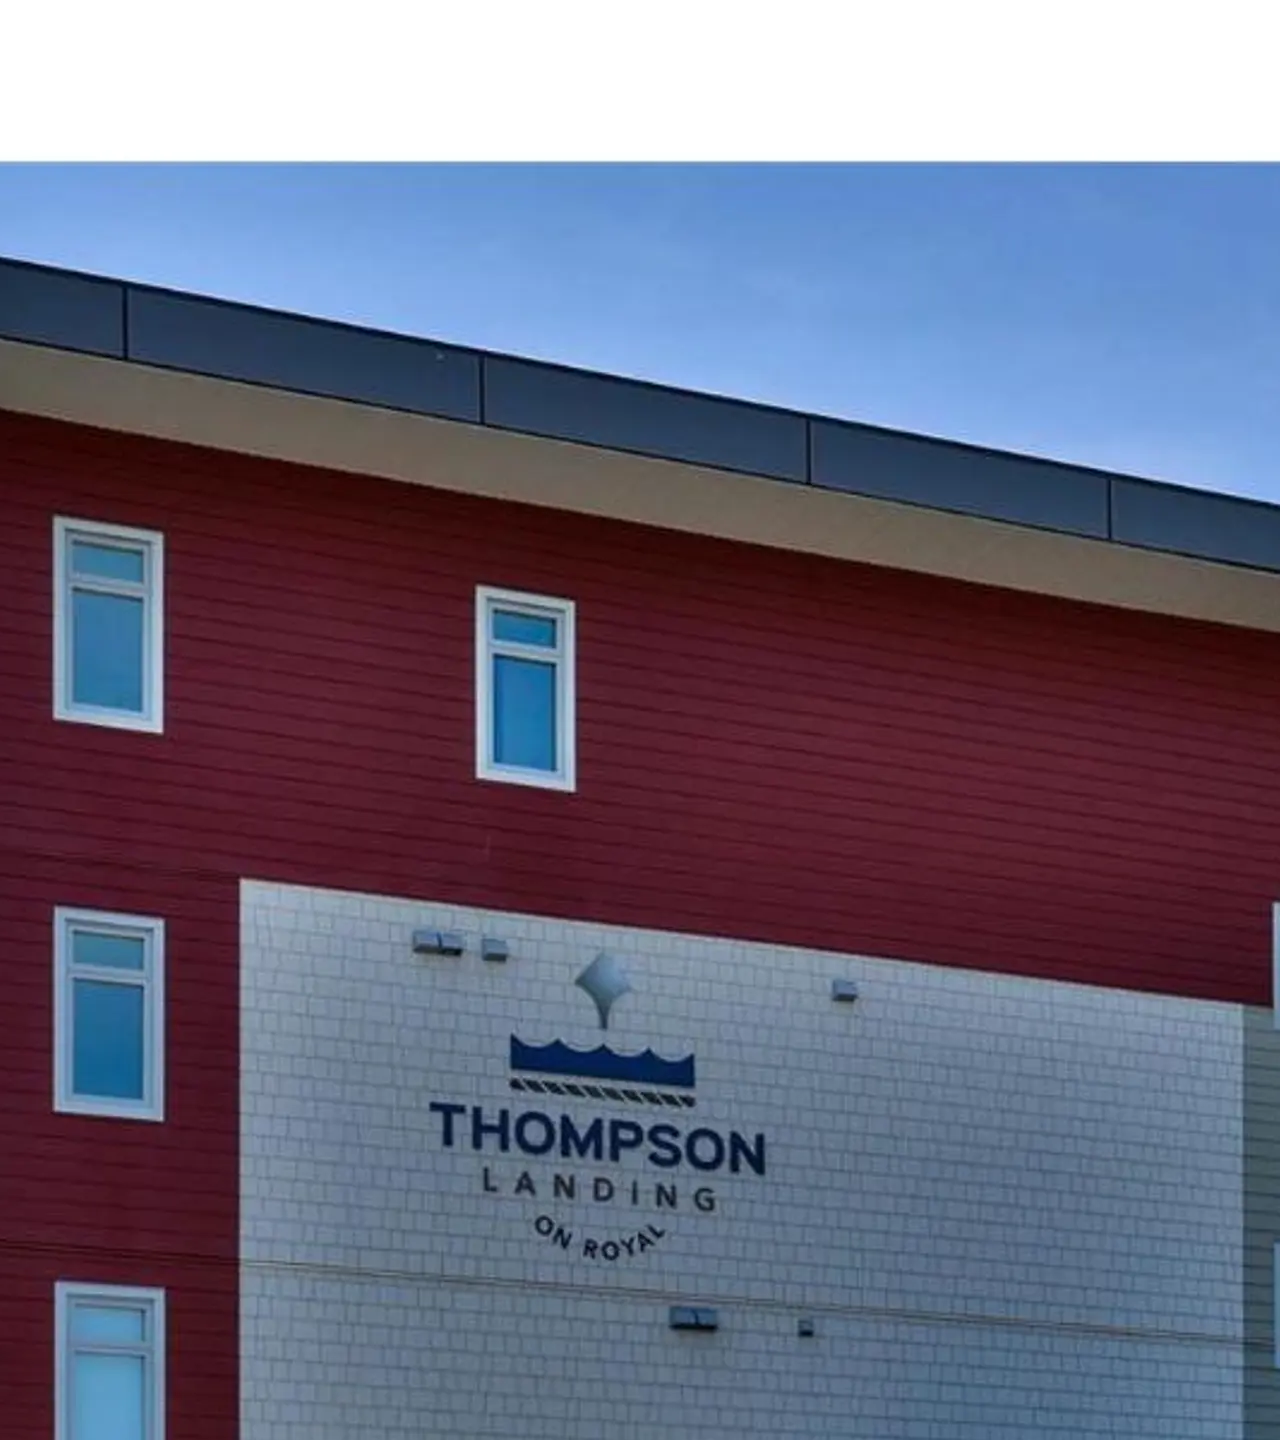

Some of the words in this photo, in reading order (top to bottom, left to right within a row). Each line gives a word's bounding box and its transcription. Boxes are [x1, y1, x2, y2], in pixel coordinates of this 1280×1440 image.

[429, 1101, 766, 1176] THOMPSON
[482, 1166, 716, 1212] LANDING
[534, 1215, 573, 1249] ON
[583, 1223, 666, 1261] ROYAL
